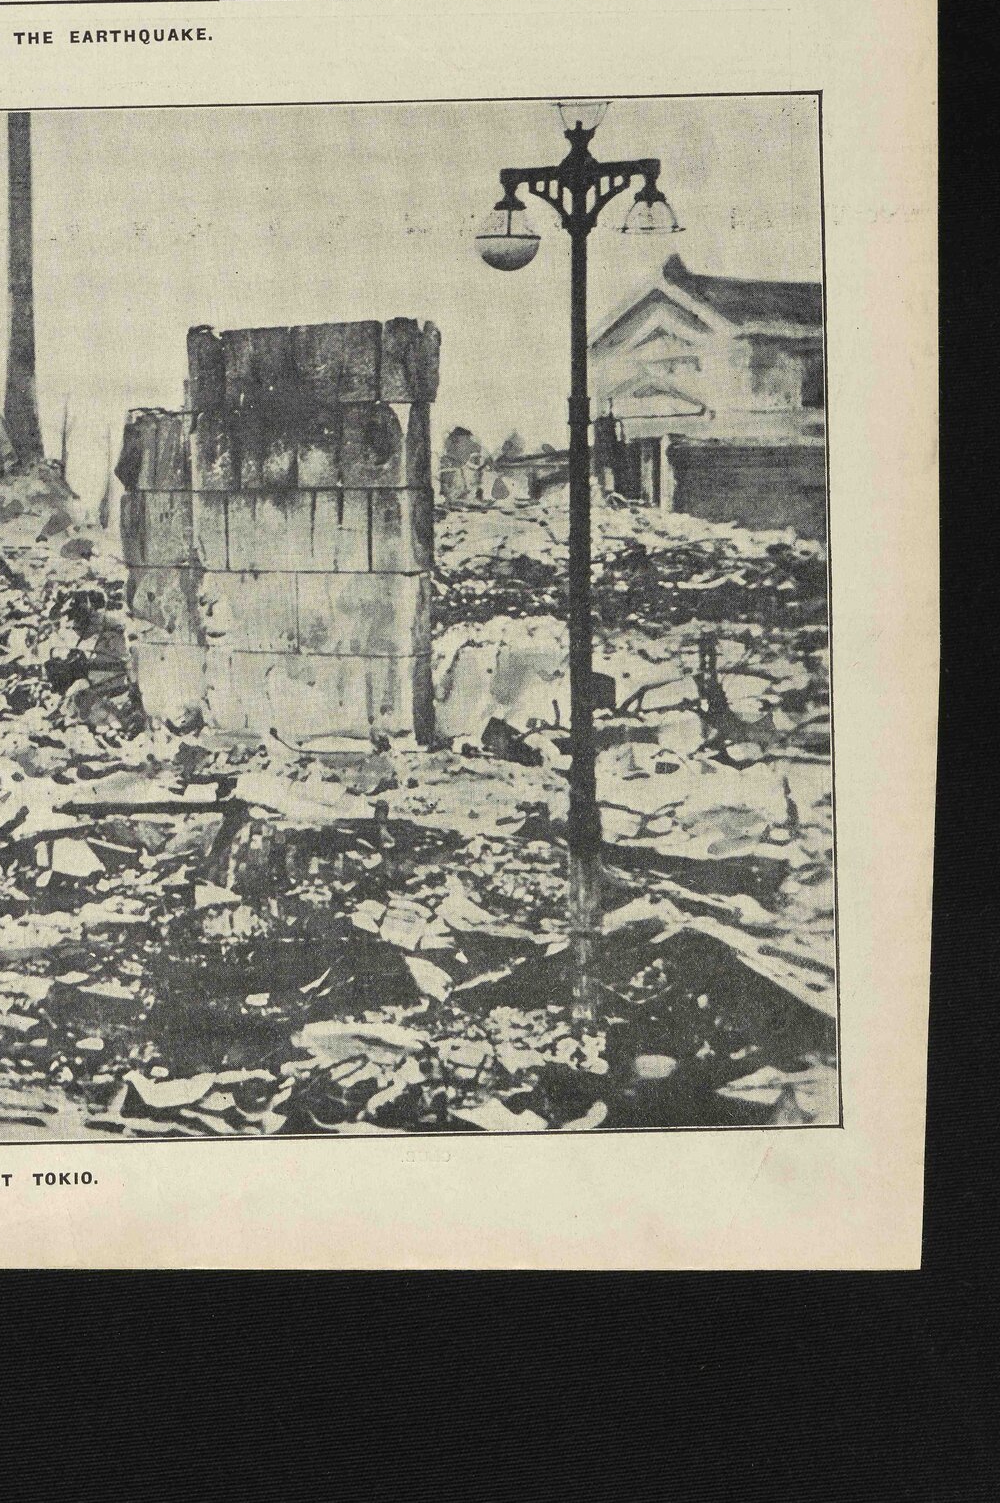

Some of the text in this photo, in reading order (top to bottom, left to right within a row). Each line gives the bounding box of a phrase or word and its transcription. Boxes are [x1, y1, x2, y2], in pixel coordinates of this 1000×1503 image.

[14, 32, 53, 45] THE
[70, 28, 214, 46] EARTHQUAKE.
[33, 1171, 98, 1186] TOKIO.
